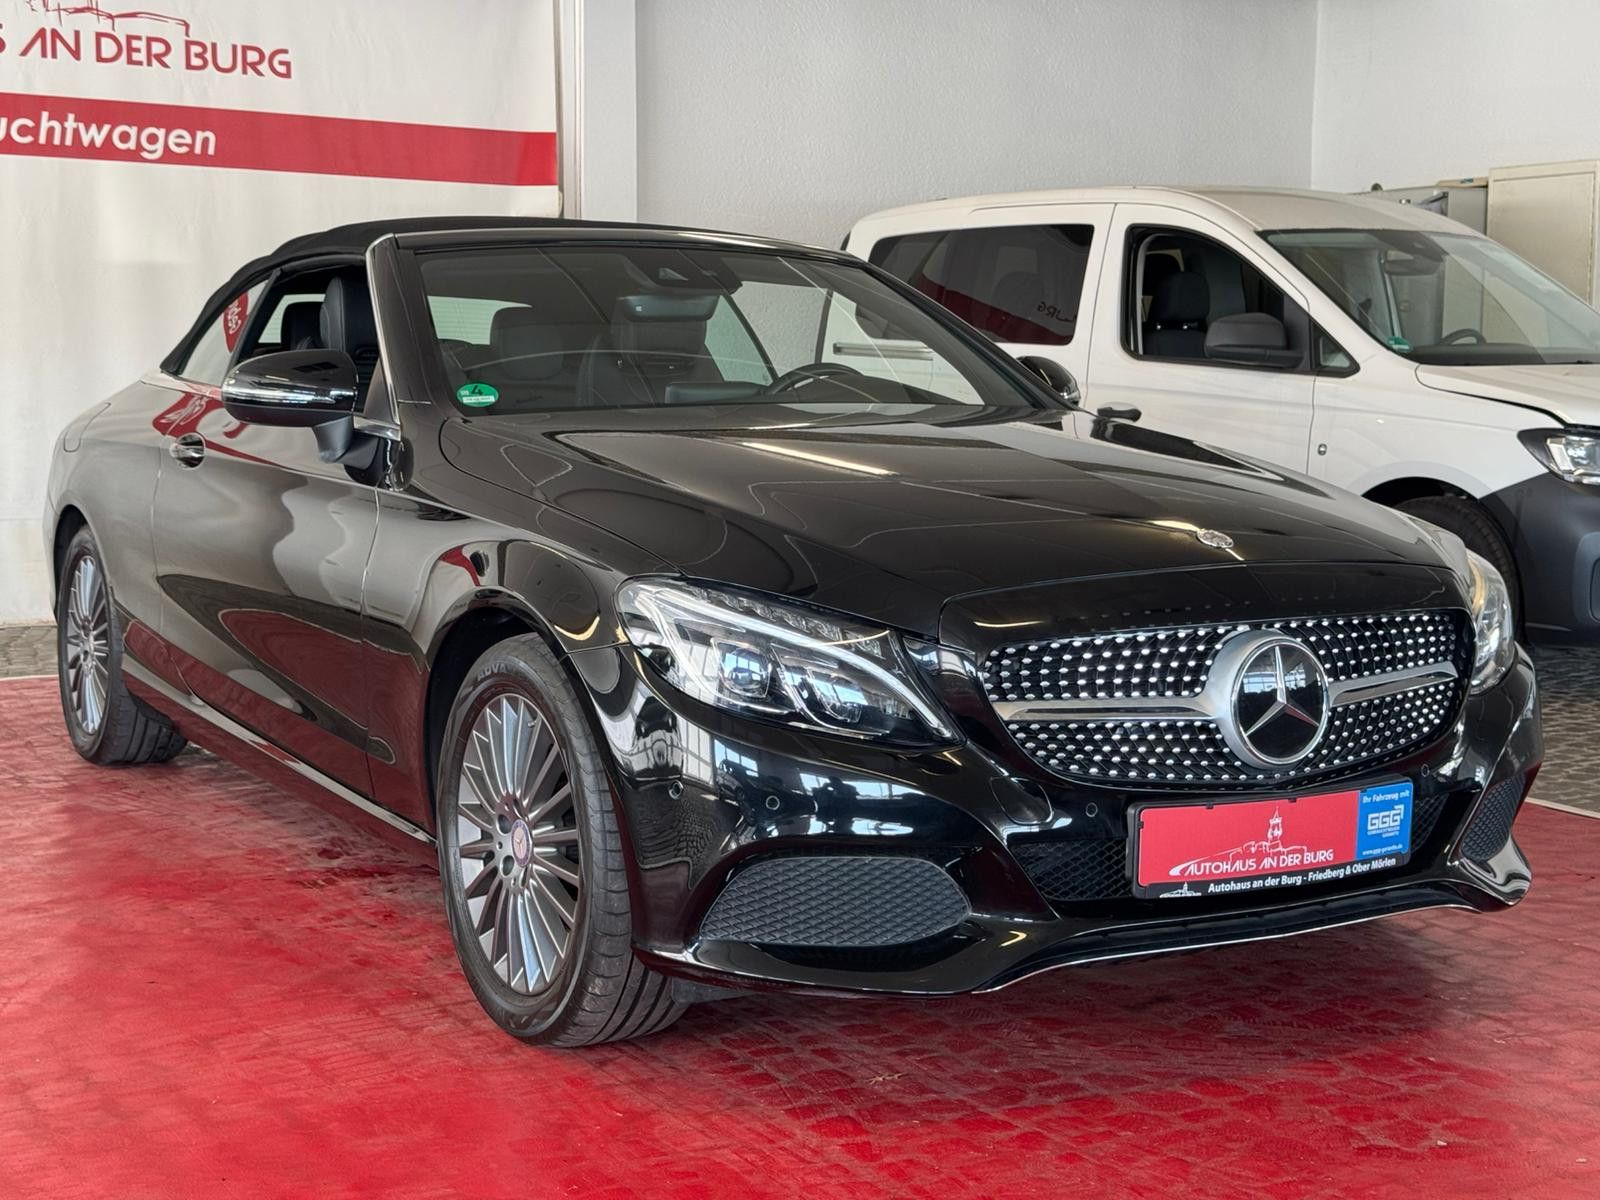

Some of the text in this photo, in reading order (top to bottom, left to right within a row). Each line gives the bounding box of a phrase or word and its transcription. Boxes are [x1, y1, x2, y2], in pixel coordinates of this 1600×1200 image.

[19, 27, 81, 61] AN
[94, 31, 172, 69] DER
[184, 39, 292, 79] BURG
[1367, 807, 1402, 831] GGG
[1184, 849, 1334, 877] AUTOHAUS AN DER BURG
[1207, 880, 1251, 893] Autohaus
[1252, 880, 1263, 888] an
[1264, 876, 1280, 887] der
[1281, 874, 1302, 886] Burg
[1308, 868, 1345, 882] Friedberg
[1345, 866, 1352, 875] &
[1352, 862, 1370, 874] Ober
[1371, 857, 1397, 871] Mörlen
